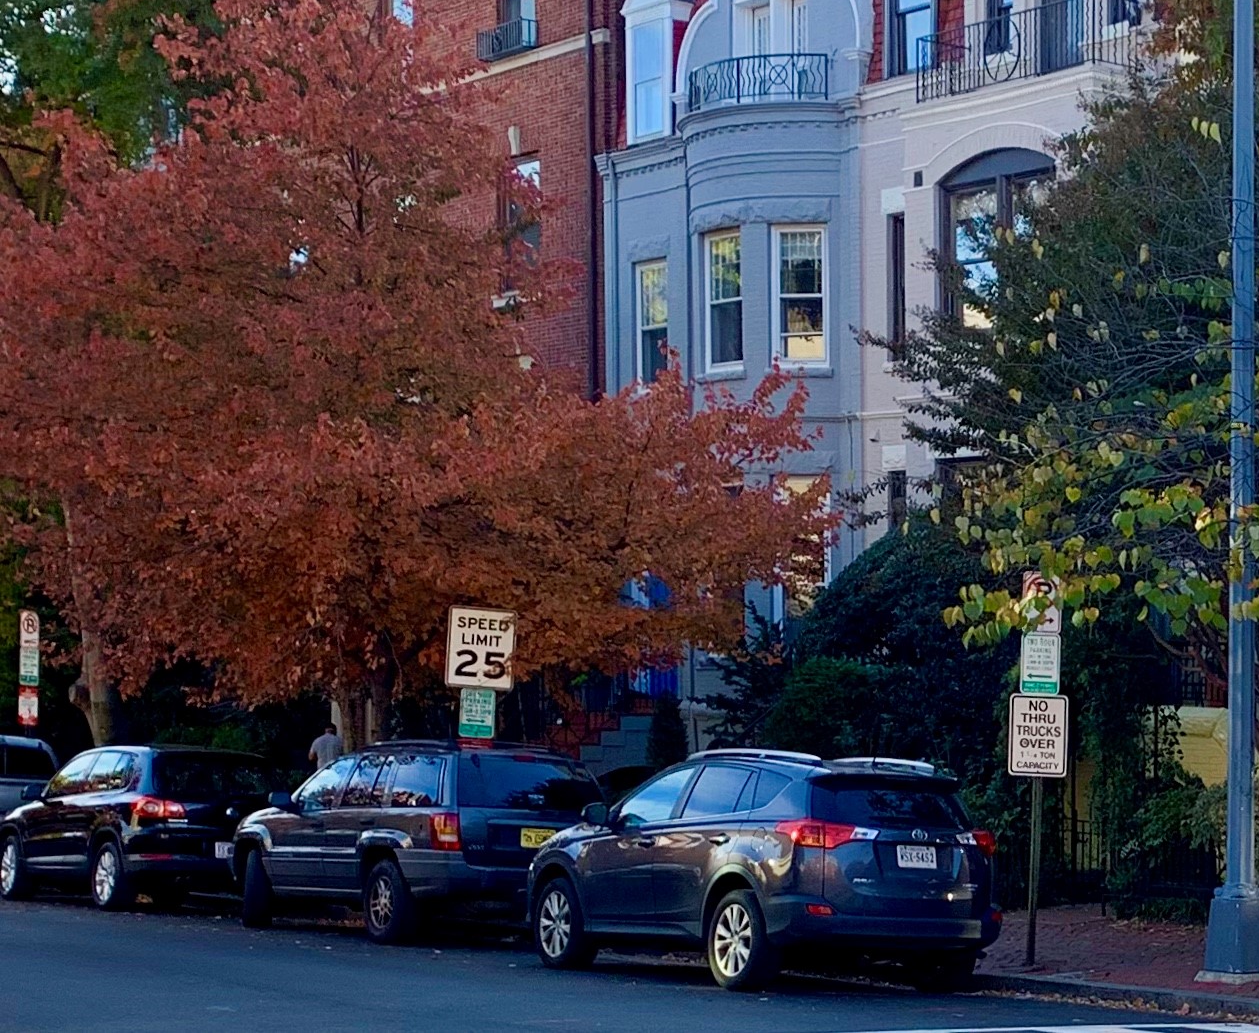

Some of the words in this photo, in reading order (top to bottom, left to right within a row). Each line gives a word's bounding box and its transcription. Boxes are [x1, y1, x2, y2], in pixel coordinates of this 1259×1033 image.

[457, 616, 510, 632] SPEED
[461, 633, 502, 648] LIMIT
[454, 649, 506, 679] 25
[1028, 700, 1048, 712] NO
[1020, 713, 1056, 724] THRU
[1016, 725, 1062, 738] TRUCKS
[1019, 738, 1055, 749] OVER
[1040, 751, 1056, 760] TON
[1016, 761, 1060, 770] CAPACITY
